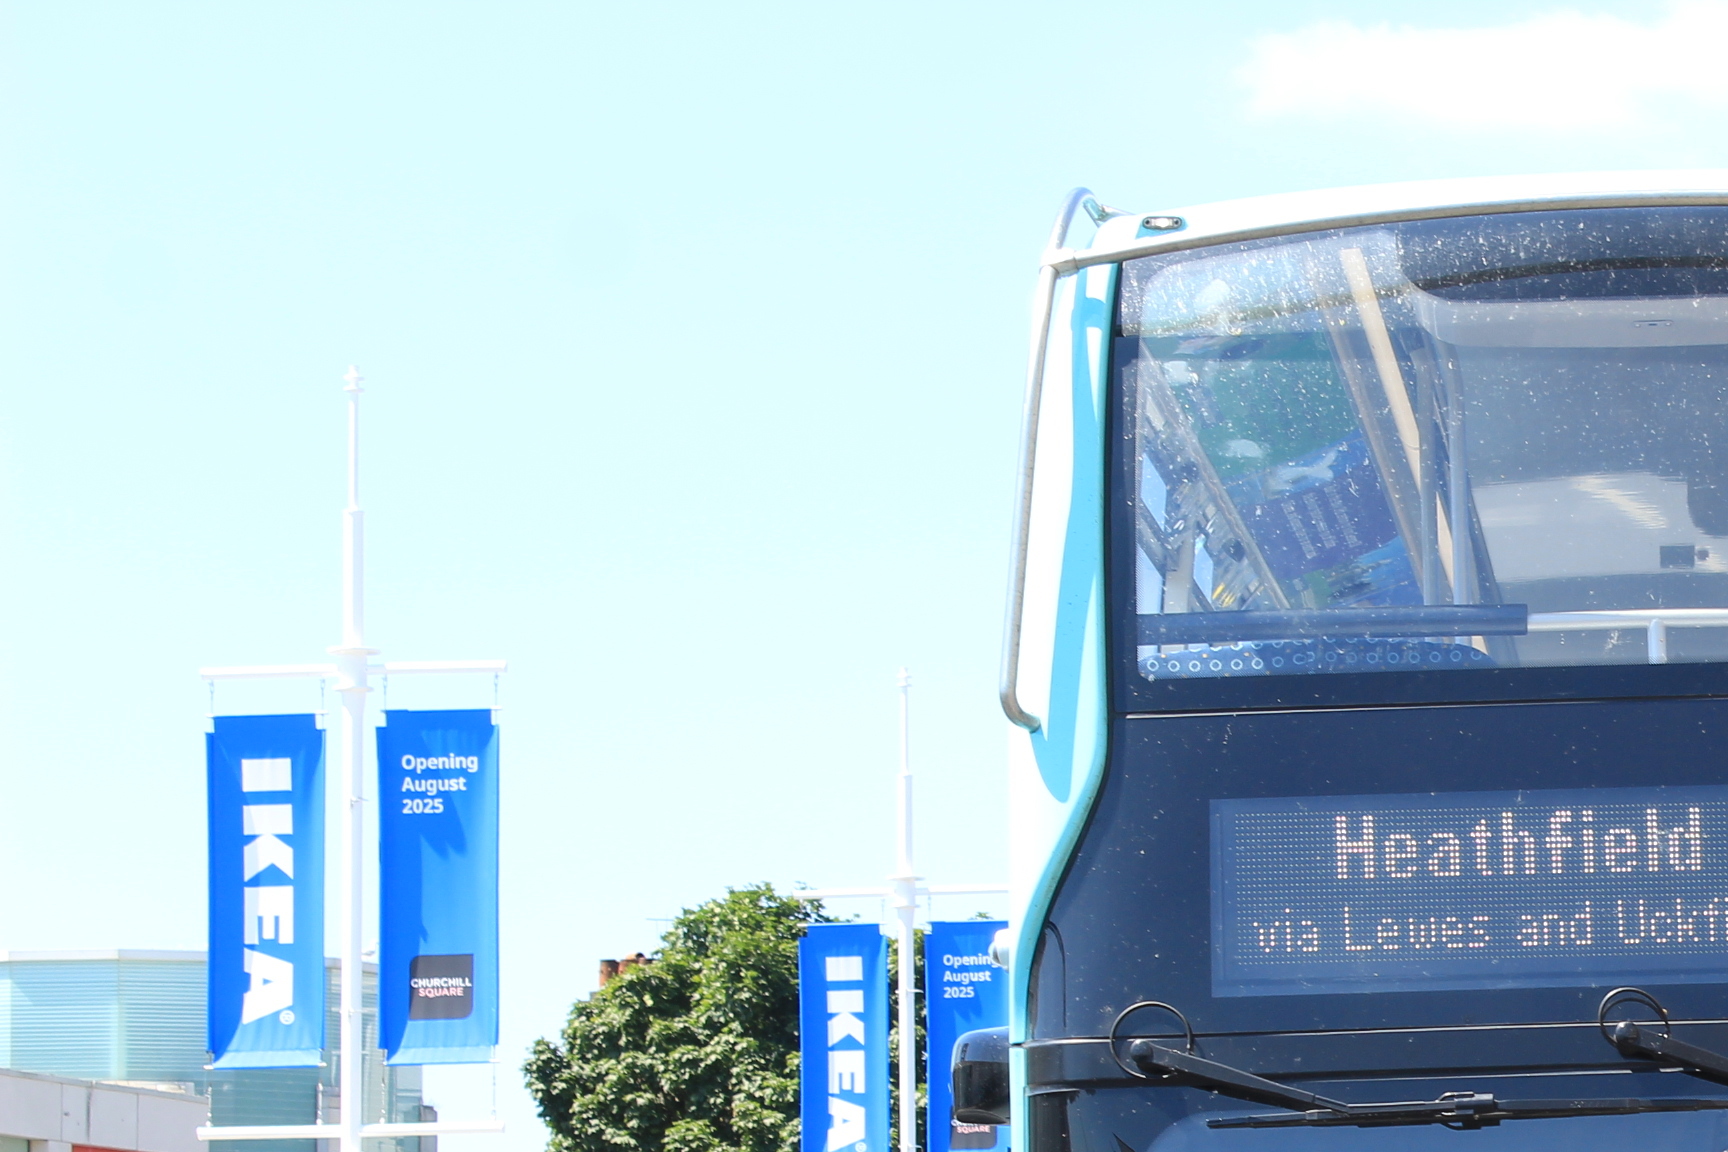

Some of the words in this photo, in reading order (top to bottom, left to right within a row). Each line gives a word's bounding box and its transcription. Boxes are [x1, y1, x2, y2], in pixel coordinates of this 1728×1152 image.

[401, 753, 479, 774] Opening
[401, 776, 467, 796] August
[402, 798, 444, 814] 2025
[1333, 805, 1703, 880] Heathfield
[241, 757, 294, 1025] IKEA
[1252, 911, 1321, 954] via
[1343, 905, 1490, 951] Lewes
[1517, 899, 1592, 948] and
[410, 976, 472, 989] CHURCHILL
[943, 970, 991, 985] August
[418, 986, 464, 998] SQUARE
[943, 986, 975, 998] 2025
[825, 956, 866, 1152] IKEA
[957, 1125, 991, 1134] SQUARE
